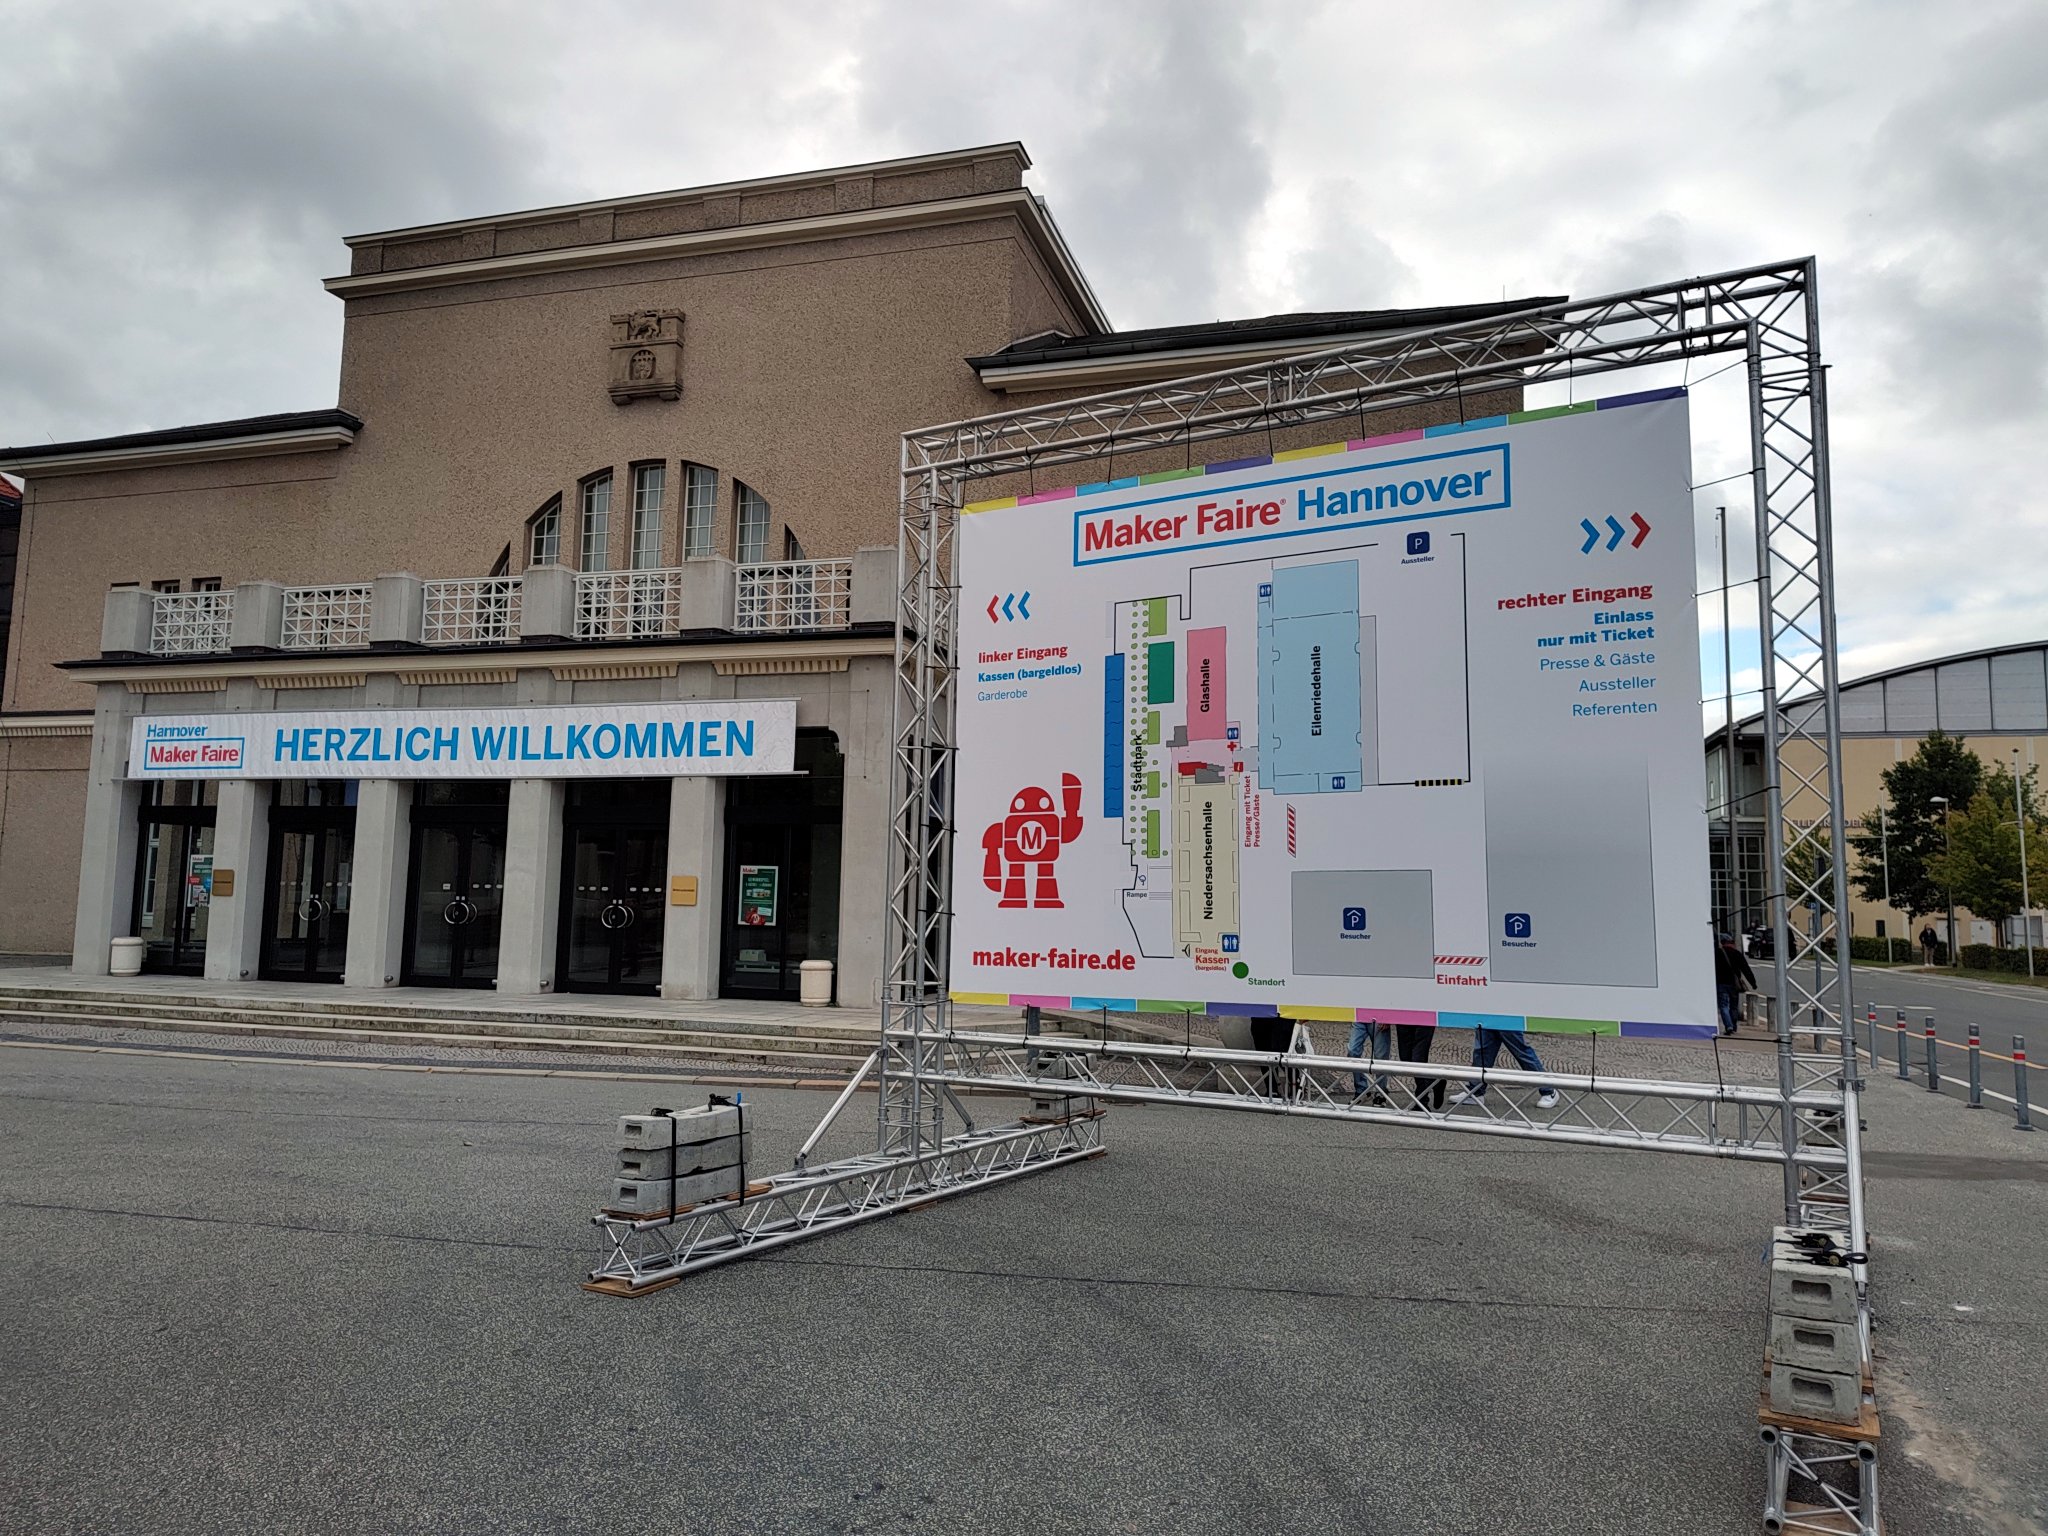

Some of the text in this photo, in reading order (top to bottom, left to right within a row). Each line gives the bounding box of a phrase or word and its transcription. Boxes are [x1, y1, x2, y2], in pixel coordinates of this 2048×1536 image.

[1085, 514, 1187, 552] Maker
[1298, 469, 1492, 521] Hannover
[1401, 556, 1435, 565] Aussteller
[1498, 584, 1653, 610] rechter Eingang
[1594, 610, 1654, 625] Einlass
[1538, 627, 1655, 648] nur mit Ticket
[978, 647, 1068, 664] linker Eingang
[1540, 651, 1656, 671] Presse & Gäste
[978, 664, 1082, 683] Kassen (bargeldlos)
[1200, 658, 1210, 713] Glashalle
[1311, 646, 1322, 736] Eilenriedehalle
[1579, 676, 1657, 693] Aussteller
[978, 688, 1028, 702] Garderobe
[1573, 701, 1658, 717] Referenten
[147, 724, 208, 737] Hannover
[275, 720, 754, 762] HERZLICH WILLKOMMEN
[151, 746, 198, 763] Maker
[1133, 734, 1145, 792] Stadtpark
[1253, 794, 1261, 848] Presse/Gäste
[1021, 827, 1042, 850] M
[1203, 801, 1214, 921] Niedersachsenhalle
[973, 948, 1136, 971] maker-faire.de
[1195, 955, 1230, 965] Kassen
[1248, 978, 1286, 987] Standort
[1437, 974, 1488, 987] Einfahrt
